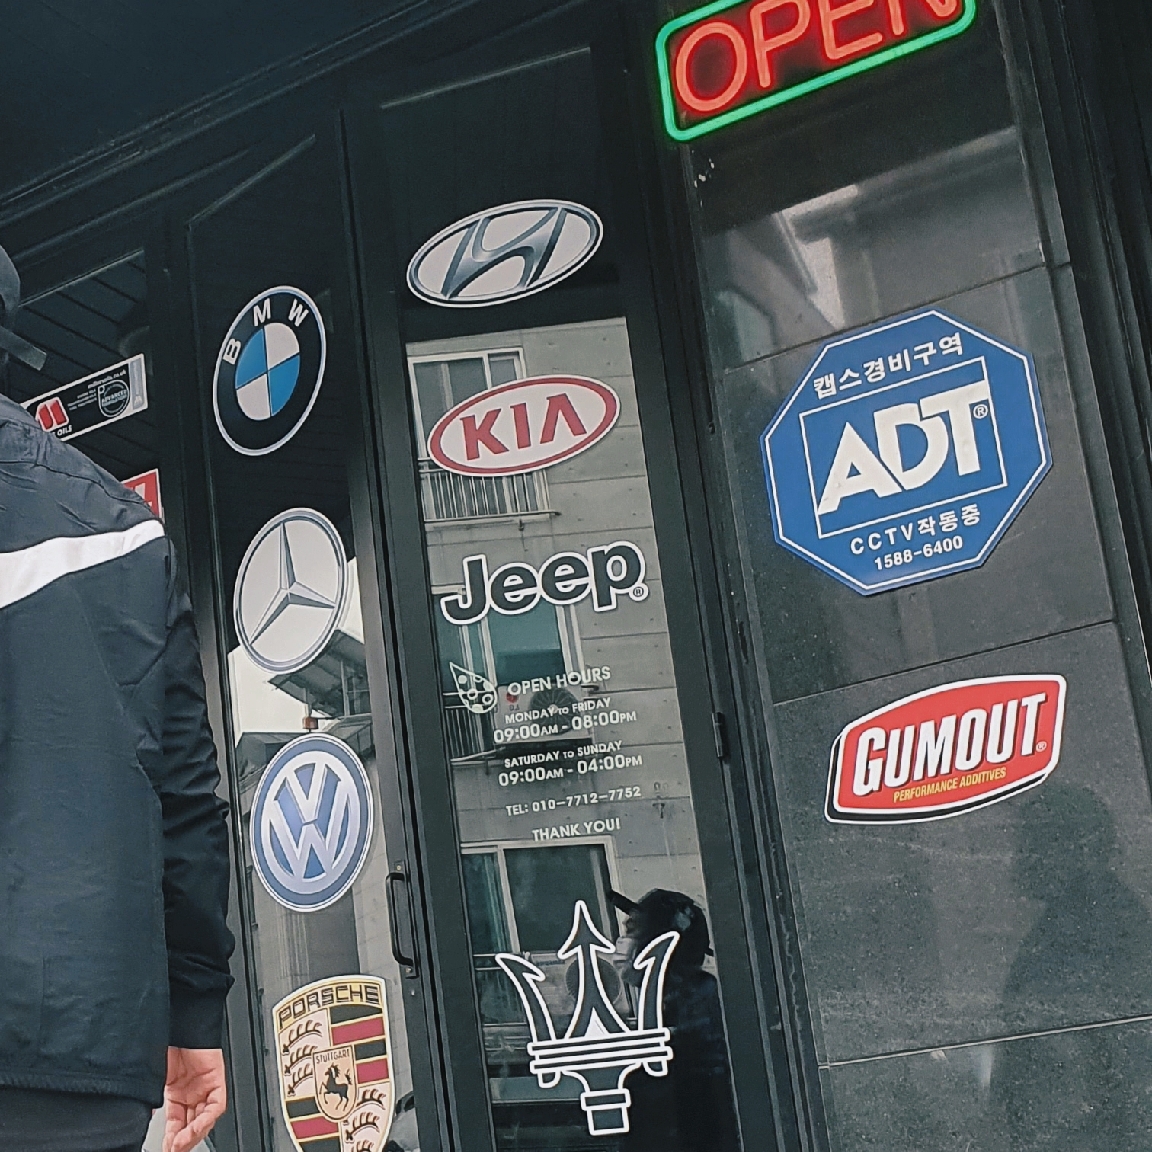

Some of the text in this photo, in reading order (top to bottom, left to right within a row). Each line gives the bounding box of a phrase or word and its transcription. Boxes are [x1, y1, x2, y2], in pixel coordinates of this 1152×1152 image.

[223, 298, 309, 365] BMW
[813, 331, 963, 400] 캡스경비구역
[459, 392, 587, 461] KIA
[817, 379, 990, 515] ADT
[850, 503, 981, 556] CCTV작동중
[874, 535, 964, 571] 1588-6400
[440, 540, 646, 625] Jeep
[507, 665, 611, 696] OPEN HOURS
[493, 723, 559, 744] 09:00AM
[571, 710, 637, 731] 08:00PM
[504, 710, 555, 724] MONDAY
[572, 697, 611, 712] FRIDAY
[504, 750, 560, 769] SATURDAY
[577, 740, 623, 757] SUNDAY
[852, 693, 1046, 797] GUMOUT
[498, 767, 564, 787] 09:00AM
[577, 754, 643, 775] 04:00PM
[893, 766, 1006, 803] PERFORMANCE ADDITIVES
[506, 803, 529, 816] TEL:
[532, 818, 621, 842] THANK YOU!
[278, 984, 380, 1030] PORSCHE
